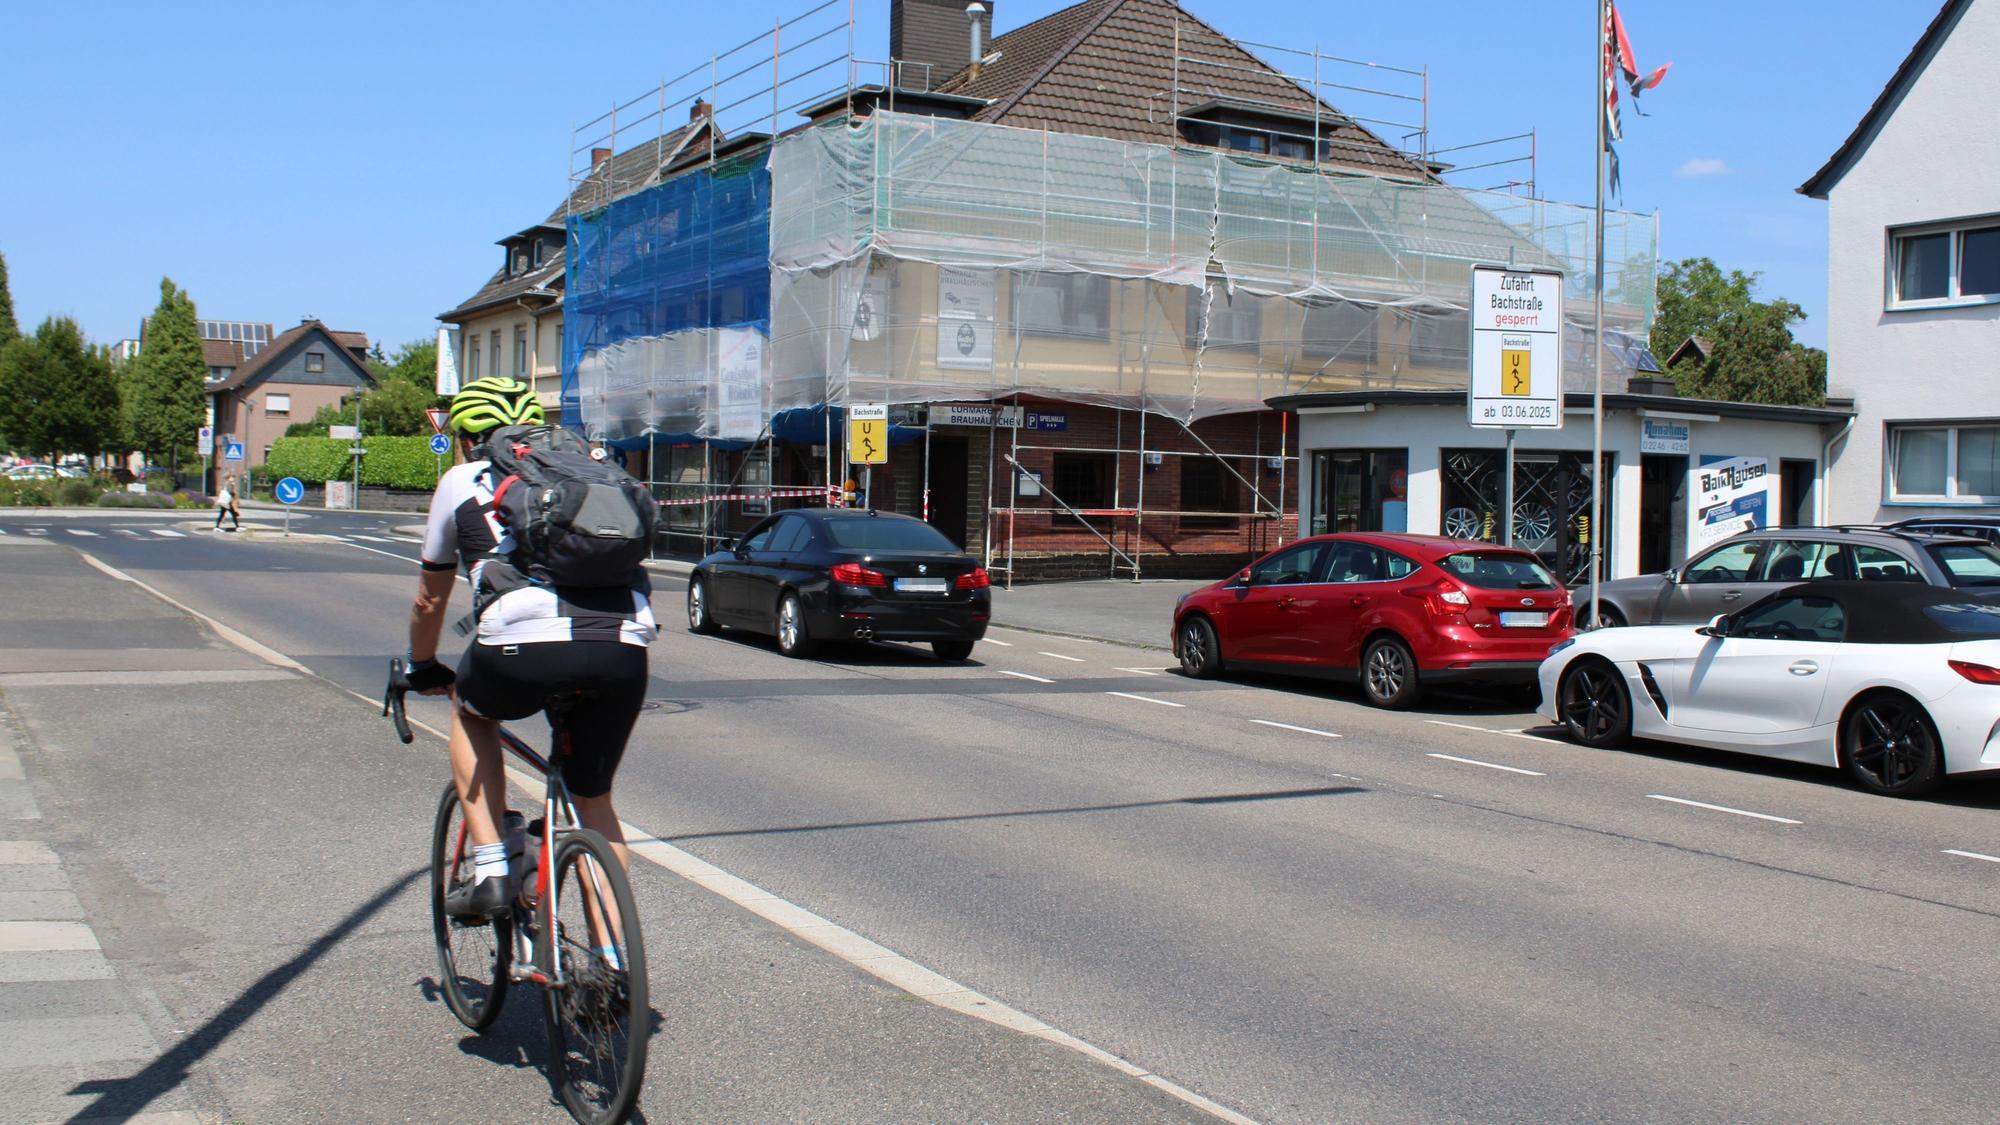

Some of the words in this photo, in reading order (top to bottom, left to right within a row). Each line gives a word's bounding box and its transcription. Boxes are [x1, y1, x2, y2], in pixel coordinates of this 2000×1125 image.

[1500, 275, 1534, 292] Zufahrt
[1491, 294, 1543, 311] Bachstraße
[1495, 313, 1538, 327] gesperrt
[1503, 338, 1530, 347] Bachstraße
[1512, 354, 1520, 367] U
[854, 407, 884, 416] Bachstraße
[1483, 405, 1496, 418] ab
[1501, 405, 1551, 418] 03.06.2025
[951, 415, 1021, 427] BRAUHÄUCHEN
[1039, 415, 1065, 423] SPIELHALLE
[862, 422, 871, 434] U
[1644, 420, 1689, 440] Annahme
